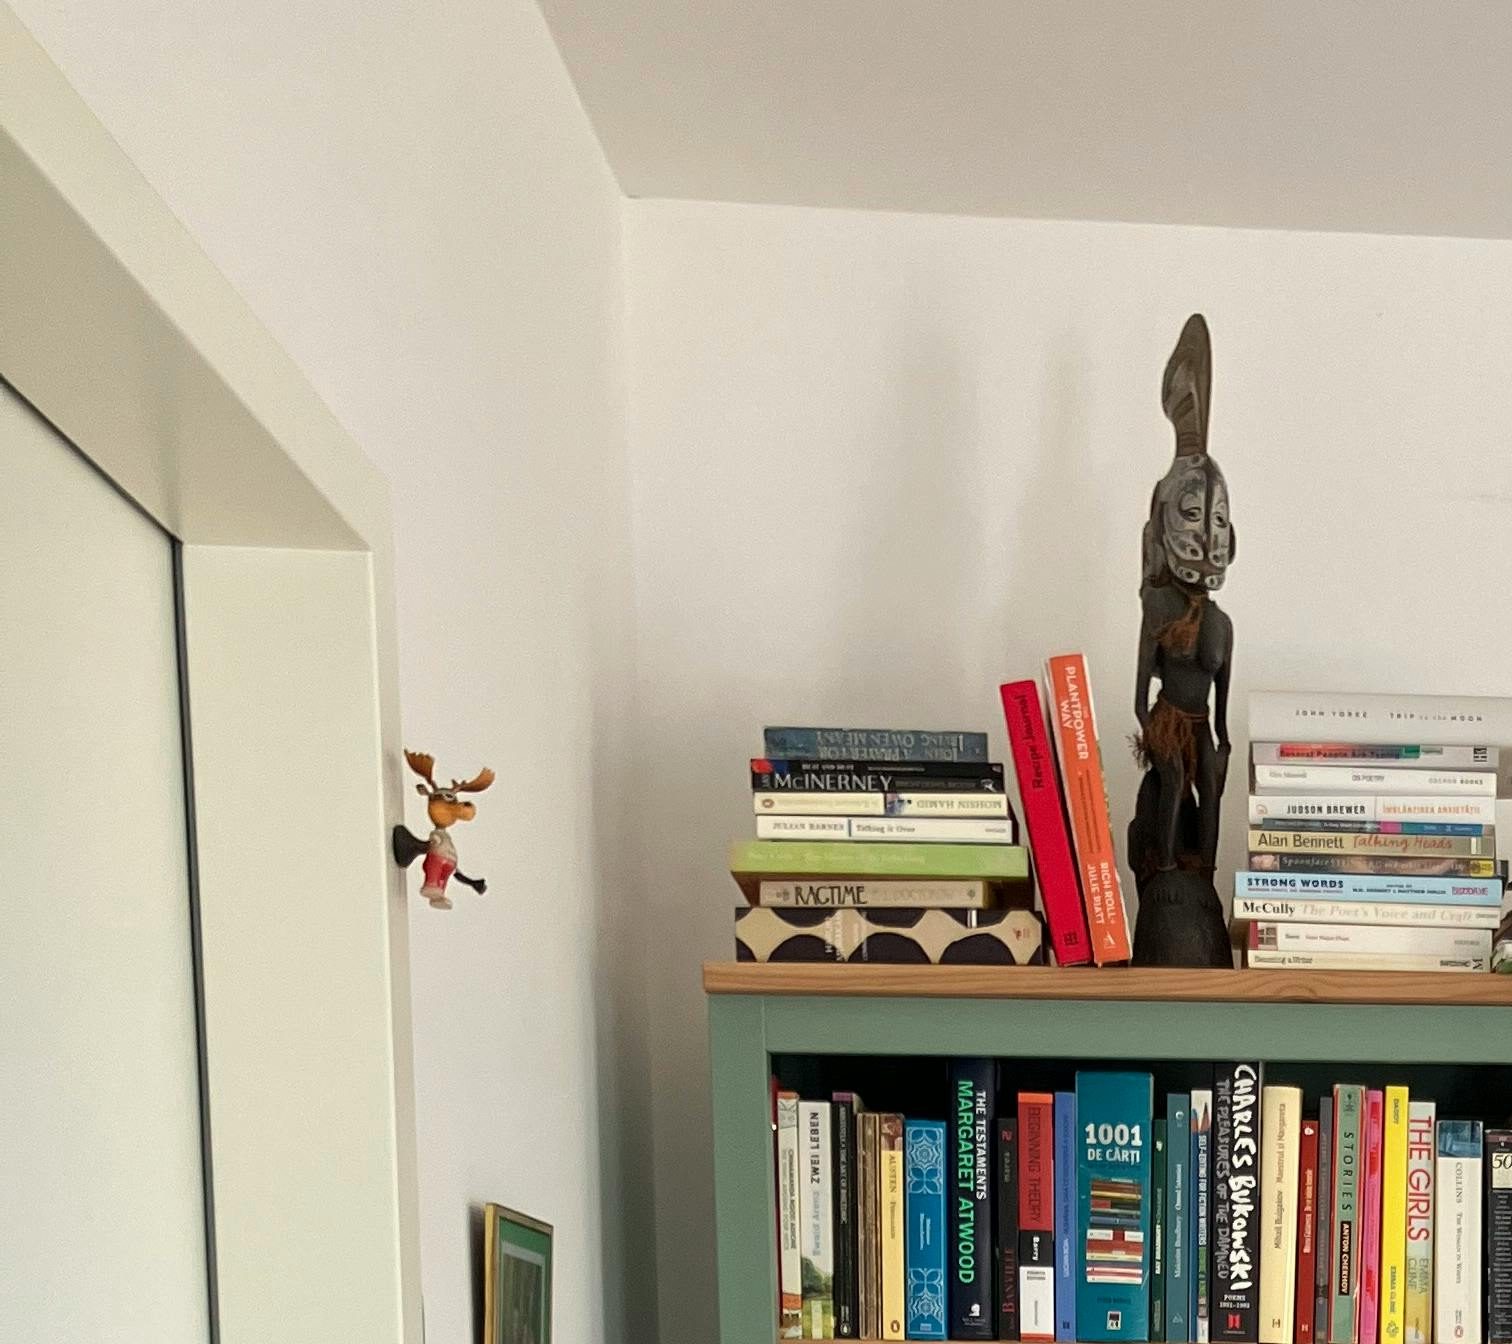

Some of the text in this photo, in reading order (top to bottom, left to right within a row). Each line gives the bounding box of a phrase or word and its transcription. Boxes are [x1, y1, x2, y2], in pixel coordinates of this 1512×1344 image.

[1060, 700, 1073, 729] WAY
[1065, 666, 1089, 760] PLANTPOWER
[774, 773, 892, 791] McINERNEY
[917, 800, 954, 809] HAMID
[1287, 805, 1366, 814] JUDSON BREWER
[1258, 833, 1344, 848] Alan Bennett
[1353, 834, 1453, 850] Talking Heads
[1087, 864, 1100, 892] JULIE
[1099, 862, 1112, 888] RICH
[1247, 877, 1344, 889] STRONG WORDS
[795, 885, 868, 905] RAGTIME
[1242, 901, 1295, 915] McCully
[810, 1111, 820, 1184] ZWEI LEBEN
[975, 1091, 987, 1200] THE TESTAMENTS
[1085, 1123, 1143, 1146] 1001
[1028, 1107, 1041, 1223] BEGINNING THEORY
[1087, 1149, 1105, 1161] DE
[957, 1080, 975, 1284] MARGARET ATWOOD
[1216, 1080, 1230, 1279] THE PLEASURES OF THE DAMNED
[1228, 1065, 1257, 1291] CHARLES BUKOWSKI
[1342, 1132, 1354, 1212] STORIES
[1408, 1115, 1431, 1241] THE GIRLS
[1032, 1236, 1040, 1261] Barry
[1341, 1223, 1350, 1294] ANTON CHEKHOV
